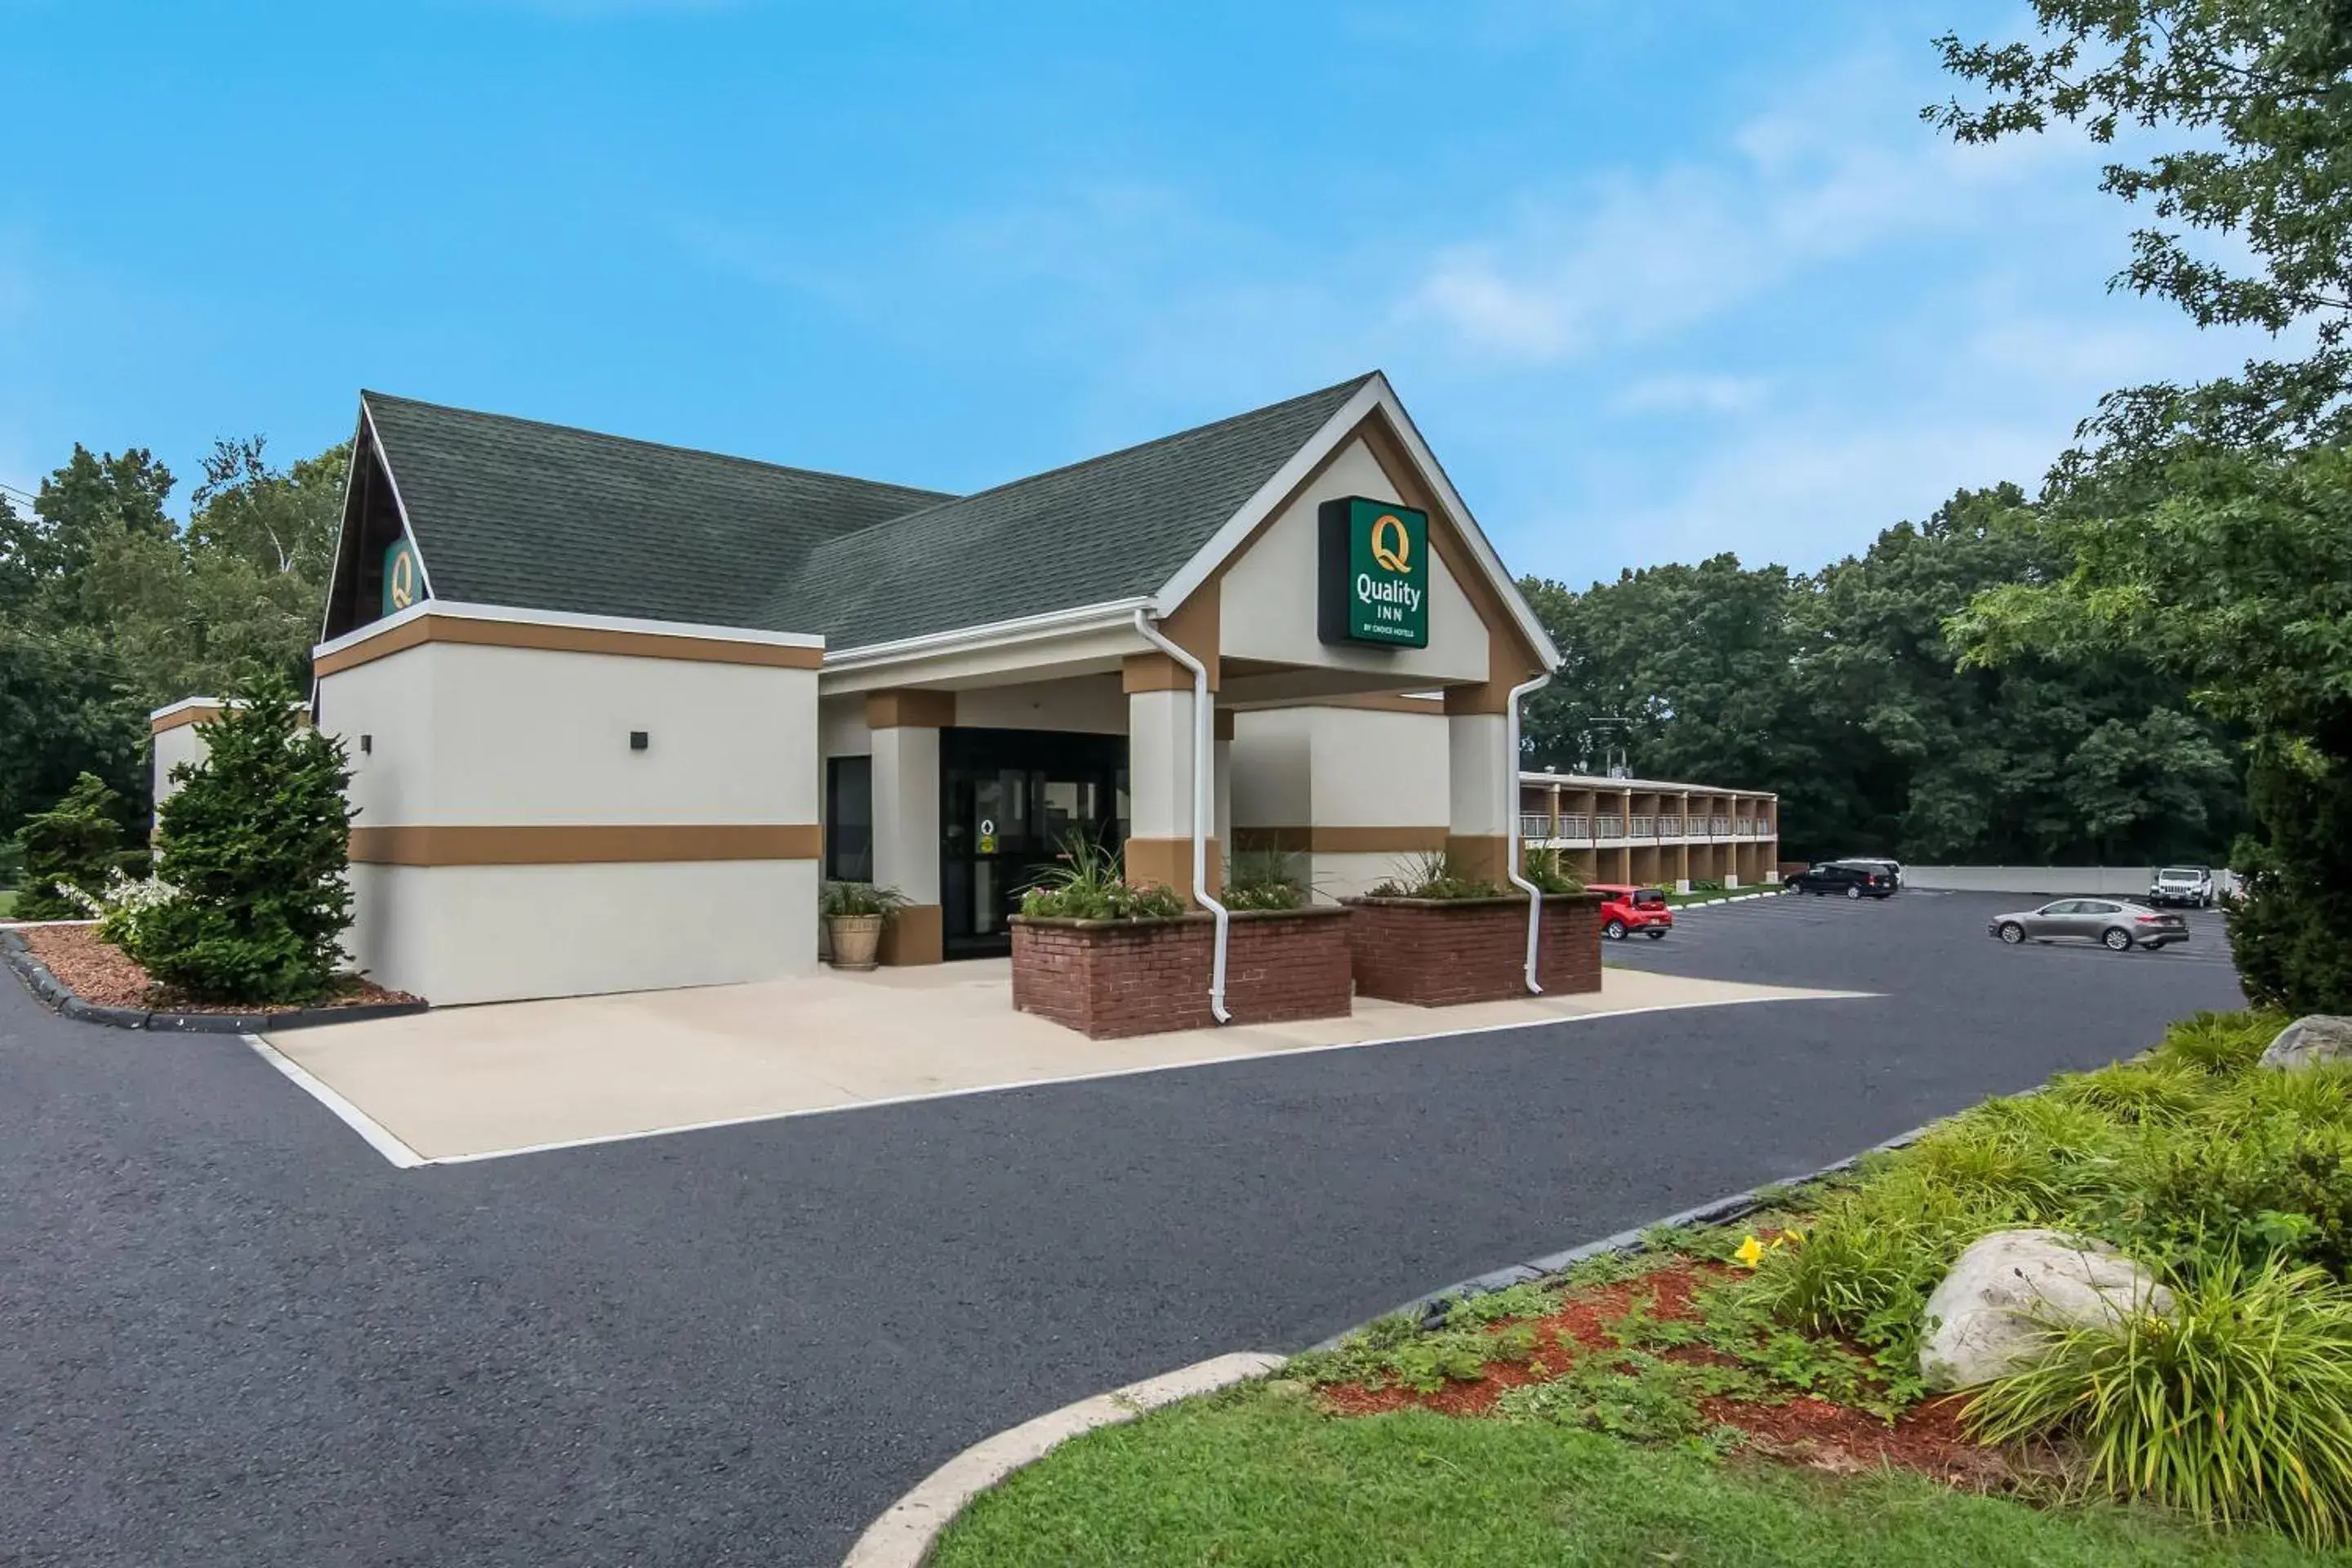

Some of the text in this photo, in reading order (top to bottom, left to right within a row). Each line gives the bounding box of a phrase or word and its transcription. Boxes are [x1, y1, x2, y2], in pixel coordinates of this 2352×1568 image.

[1372, 514, 1411, 573] Q
[392, 551, 412, 609] Q
[1356, 573, 1421, 612] Quality
[1378, 604, 1403, 621] INN
